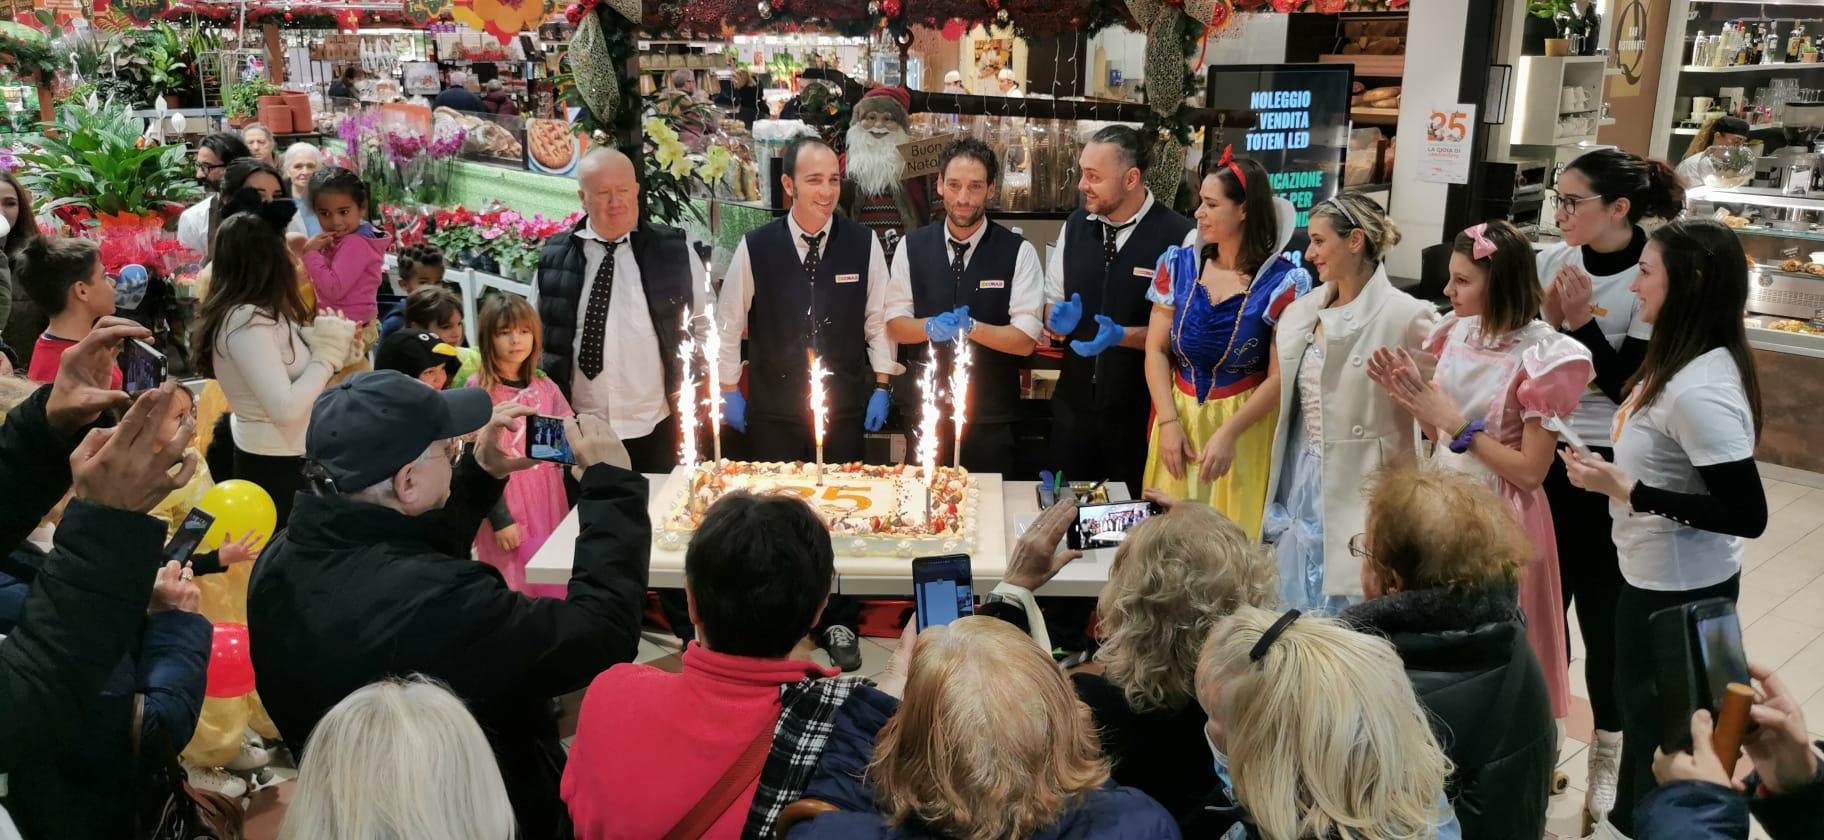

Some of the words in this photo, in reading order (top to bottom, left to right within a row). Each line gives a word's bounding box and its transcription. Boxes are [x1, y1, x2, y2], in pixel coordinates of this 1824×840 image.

[1250, 90, 1311, 109] NOLEGGIO
[1259, 111, 1309, 130] VENDITA
[1427, 112, 1467, 142] 25
[911, 143, 942, 157] Buon
[1246, 133, 1284, 151] TOTEM
[1288, 131, 1309, 149] LED
